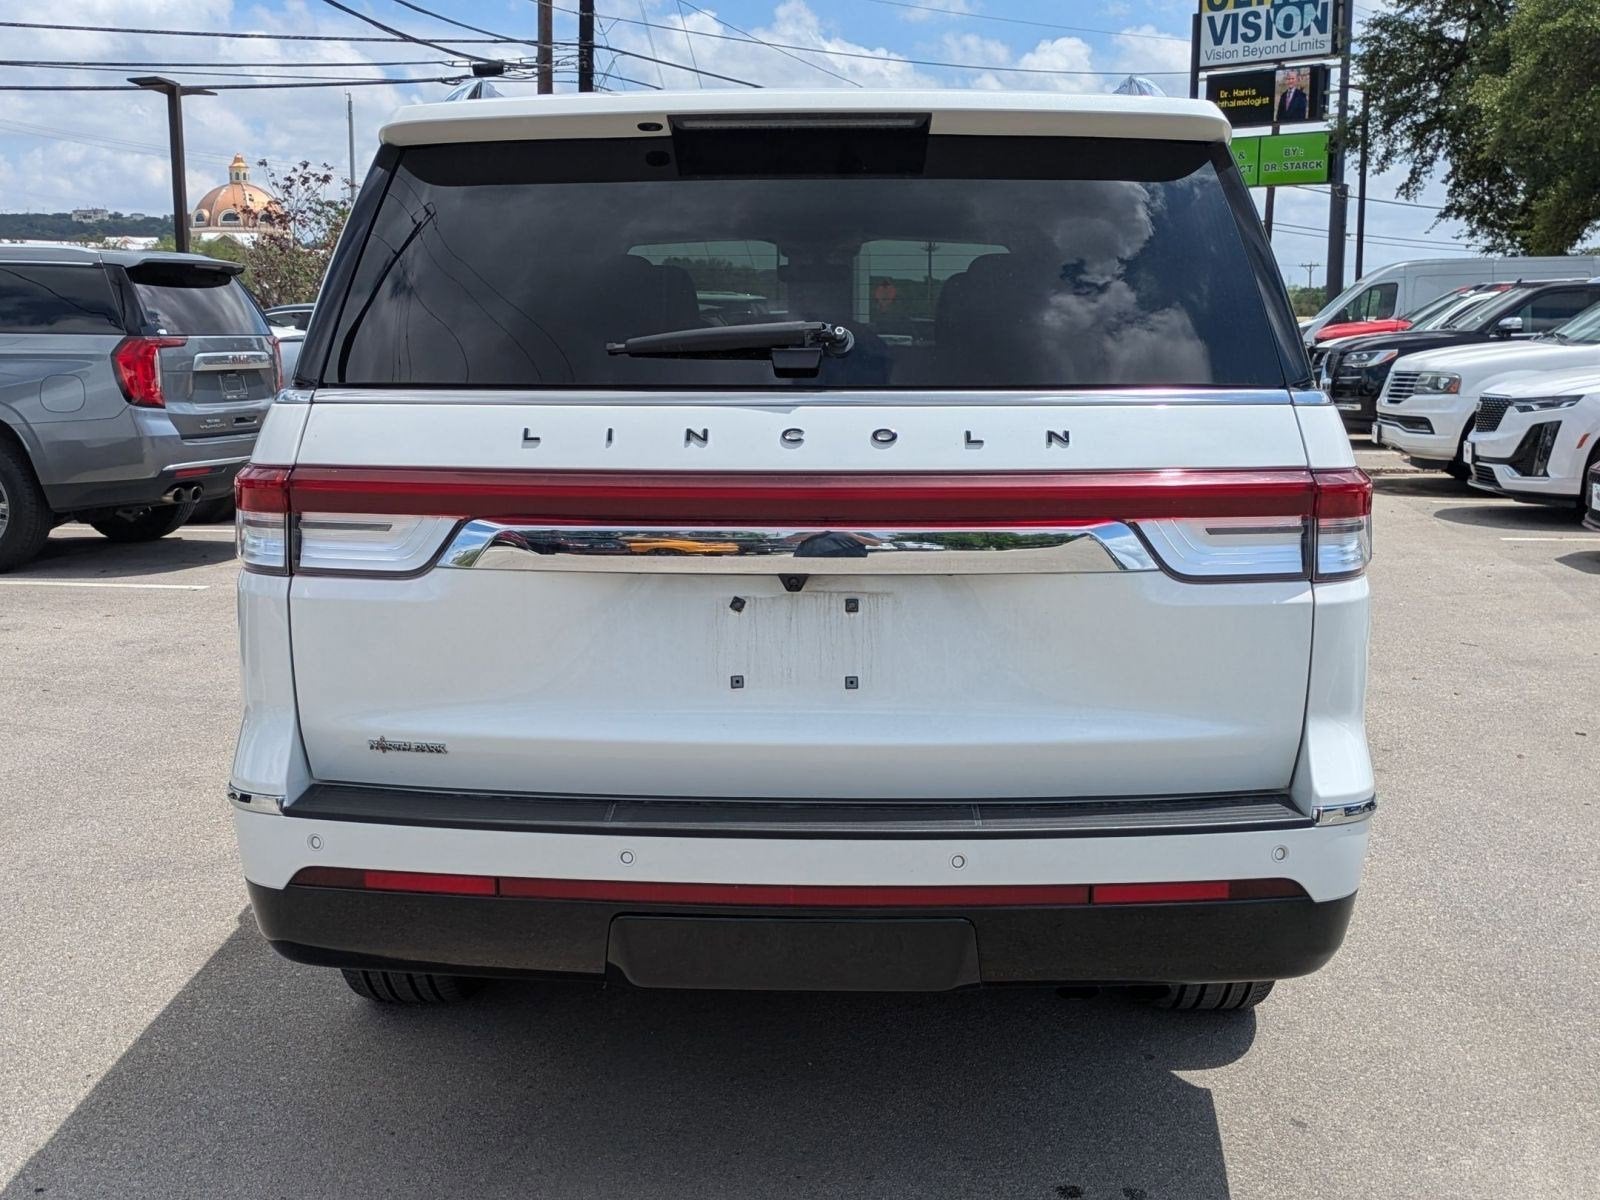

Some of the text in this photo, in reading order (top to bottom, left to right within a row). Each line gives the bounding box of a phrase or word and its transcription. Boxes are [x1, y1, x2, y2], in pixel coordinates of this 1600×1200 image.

[1206, 1, 1329, 47] VISION
[1205, 38, 1326, 61] Vision Beyond Limits
[1220, 88, 1257, 98] Dr. Harris
[1238, 151, 1246, 160] &
[1263, 160, 1323, 172] DR. STARCK
[522, 427, 1070, 448] LINCOLN
